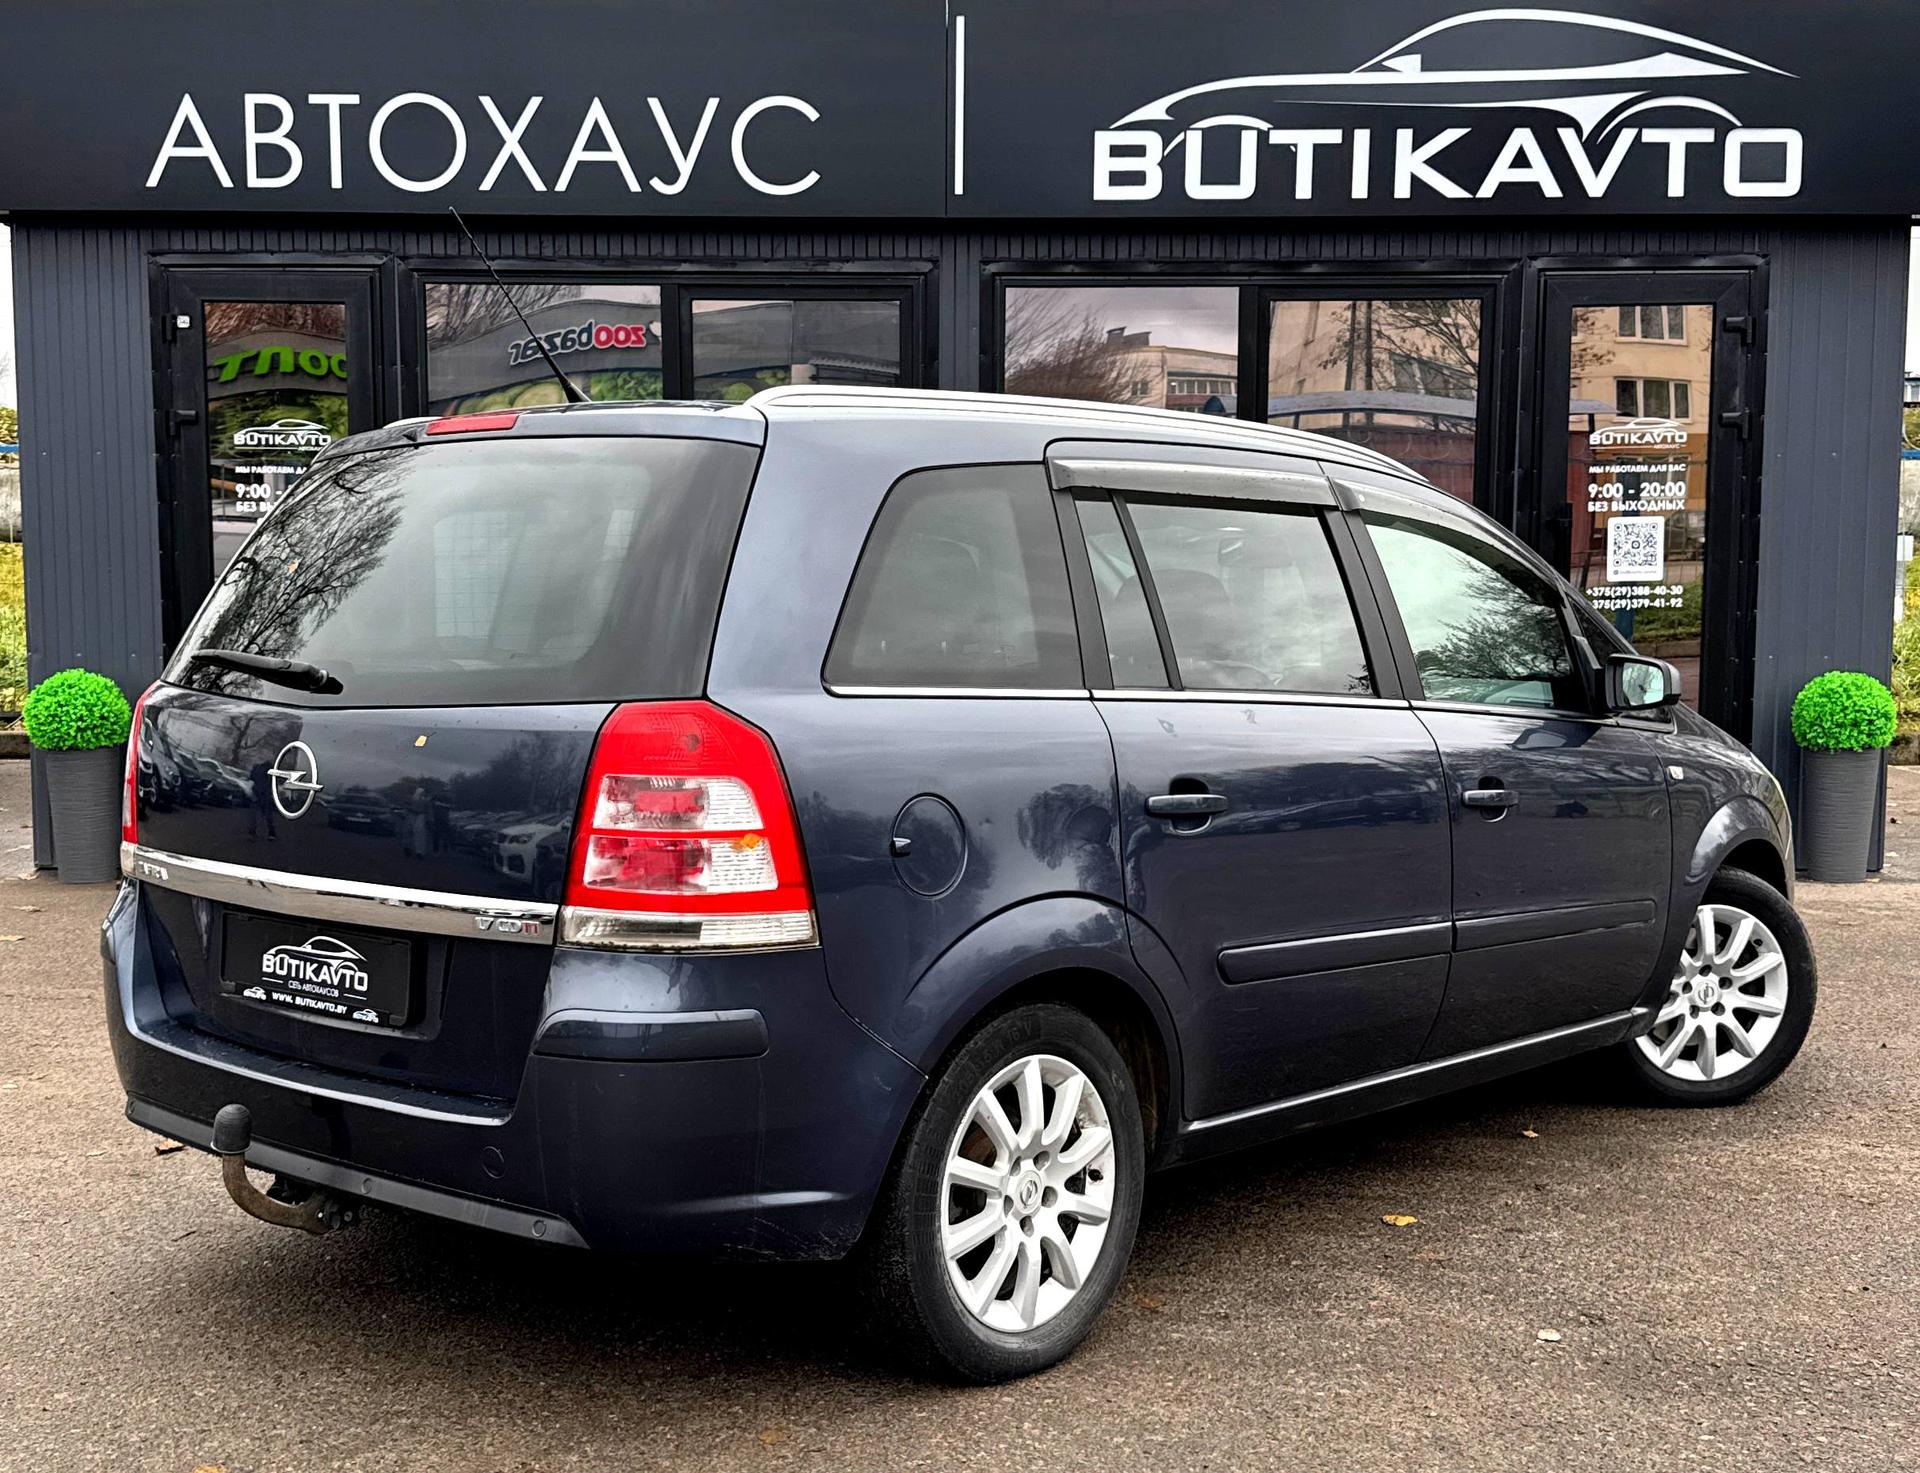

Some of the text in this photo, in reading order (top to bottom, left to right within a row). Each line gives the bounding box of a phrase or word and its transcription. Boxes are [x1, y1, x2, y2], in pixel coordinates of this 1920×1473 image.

[145, 93, 821, 196] АВТОХАУС
[1093, 126, 1804, 201] BUTIKAVTO
[233, 432, 332, 446] BUTIKAVTO
[1589, 431, 1688, 445] BUTIKAVTO
[234, 466, 250, 474] МЫ
[251, 466, 294, 474] РАБОТАЕМ
[1589, 463, 1687, 474] МЫ РАБОТАЕМ ДЛЯ ВАС
[235, 483, 271, 499] 9:00
[1588, 483, 1624, 498] 9:00
[1640, 481, 1686, 498] 20:00
[235, 501, 257, 512] БЕЗ
[1588, 500, 1685, 512] БЕЗ ВЫХОДНЫХ
[1591, 597, 1684, 611] 375(29)379-41-92
[262, 954, 368, 991] BUTIKAVTO
[294, 995, 348, 1015] BUTIKAVTO.BY
